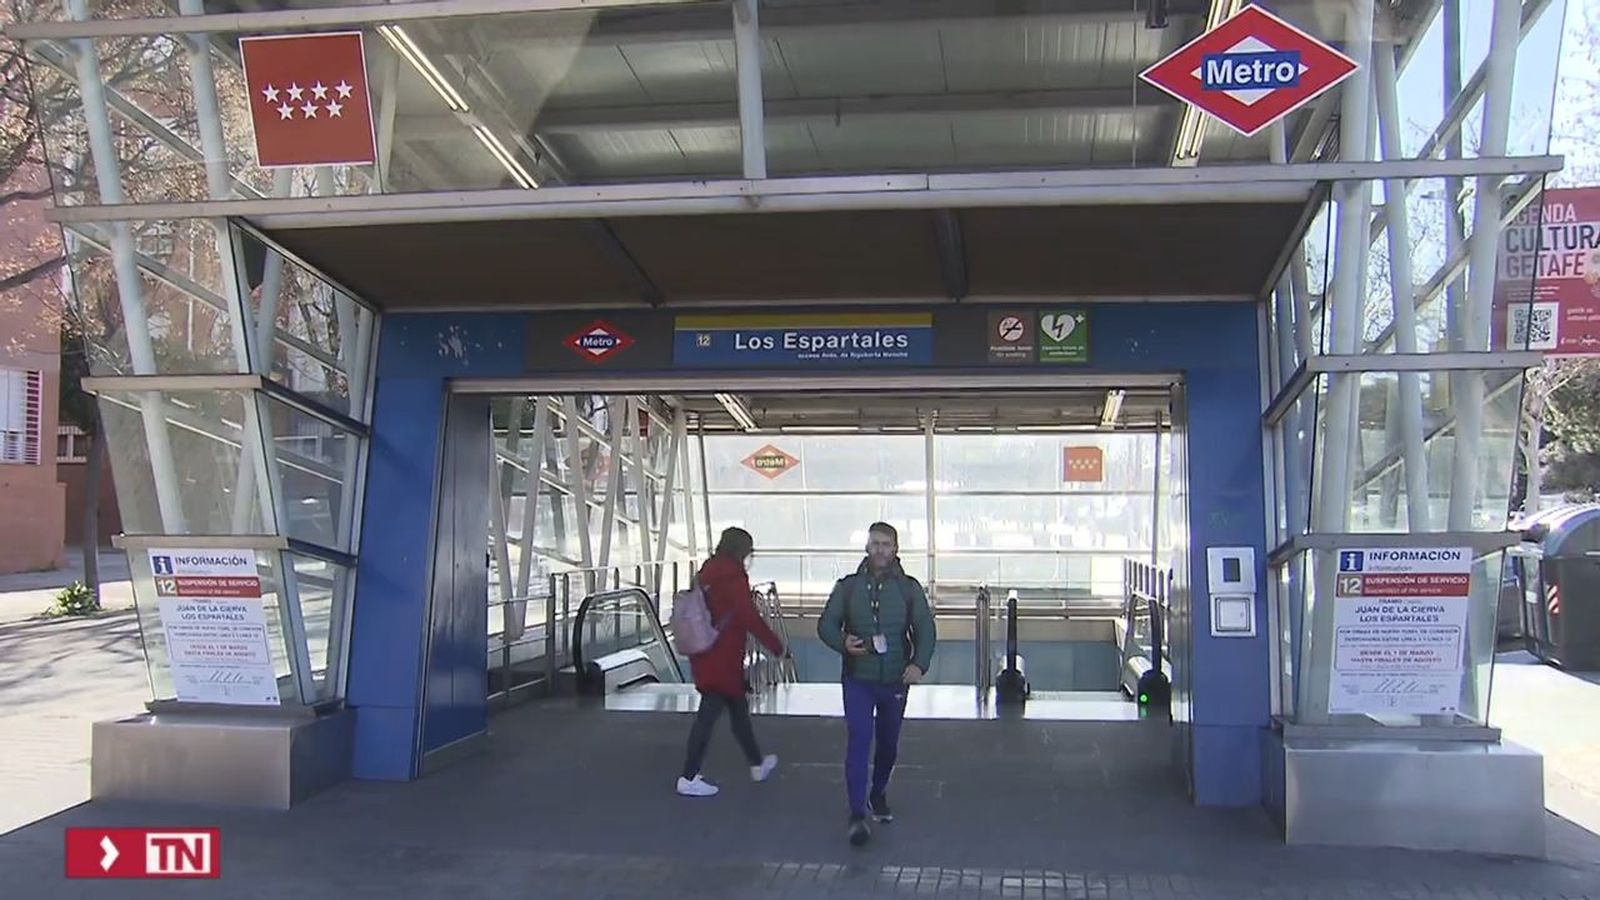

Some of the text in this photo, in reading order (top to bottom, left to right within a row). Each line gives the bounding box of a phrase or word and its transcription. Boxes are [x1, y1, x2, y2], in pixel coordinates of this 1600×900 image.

[1206, 59, 1295, 85] Metro
[1512, 203, 1577, 225] GENDA
[1507, 252, 1586, 278] GETAFE
[582, 336, 613, 347] Metro
[697, 331, 908, 352] 12 Los Espartales
[175, 556, 248, 567] INFORMACIÓN
[157, 579, 178, 594] 12
[1340, 575, 1468, 595] 12 SUSPENSIÓN DE SERVICIO
[1355, 606, 1445, 614] JUAN DE LA CIERVA
[1359, 614, 1439, 623] LOS ESPARTALES
